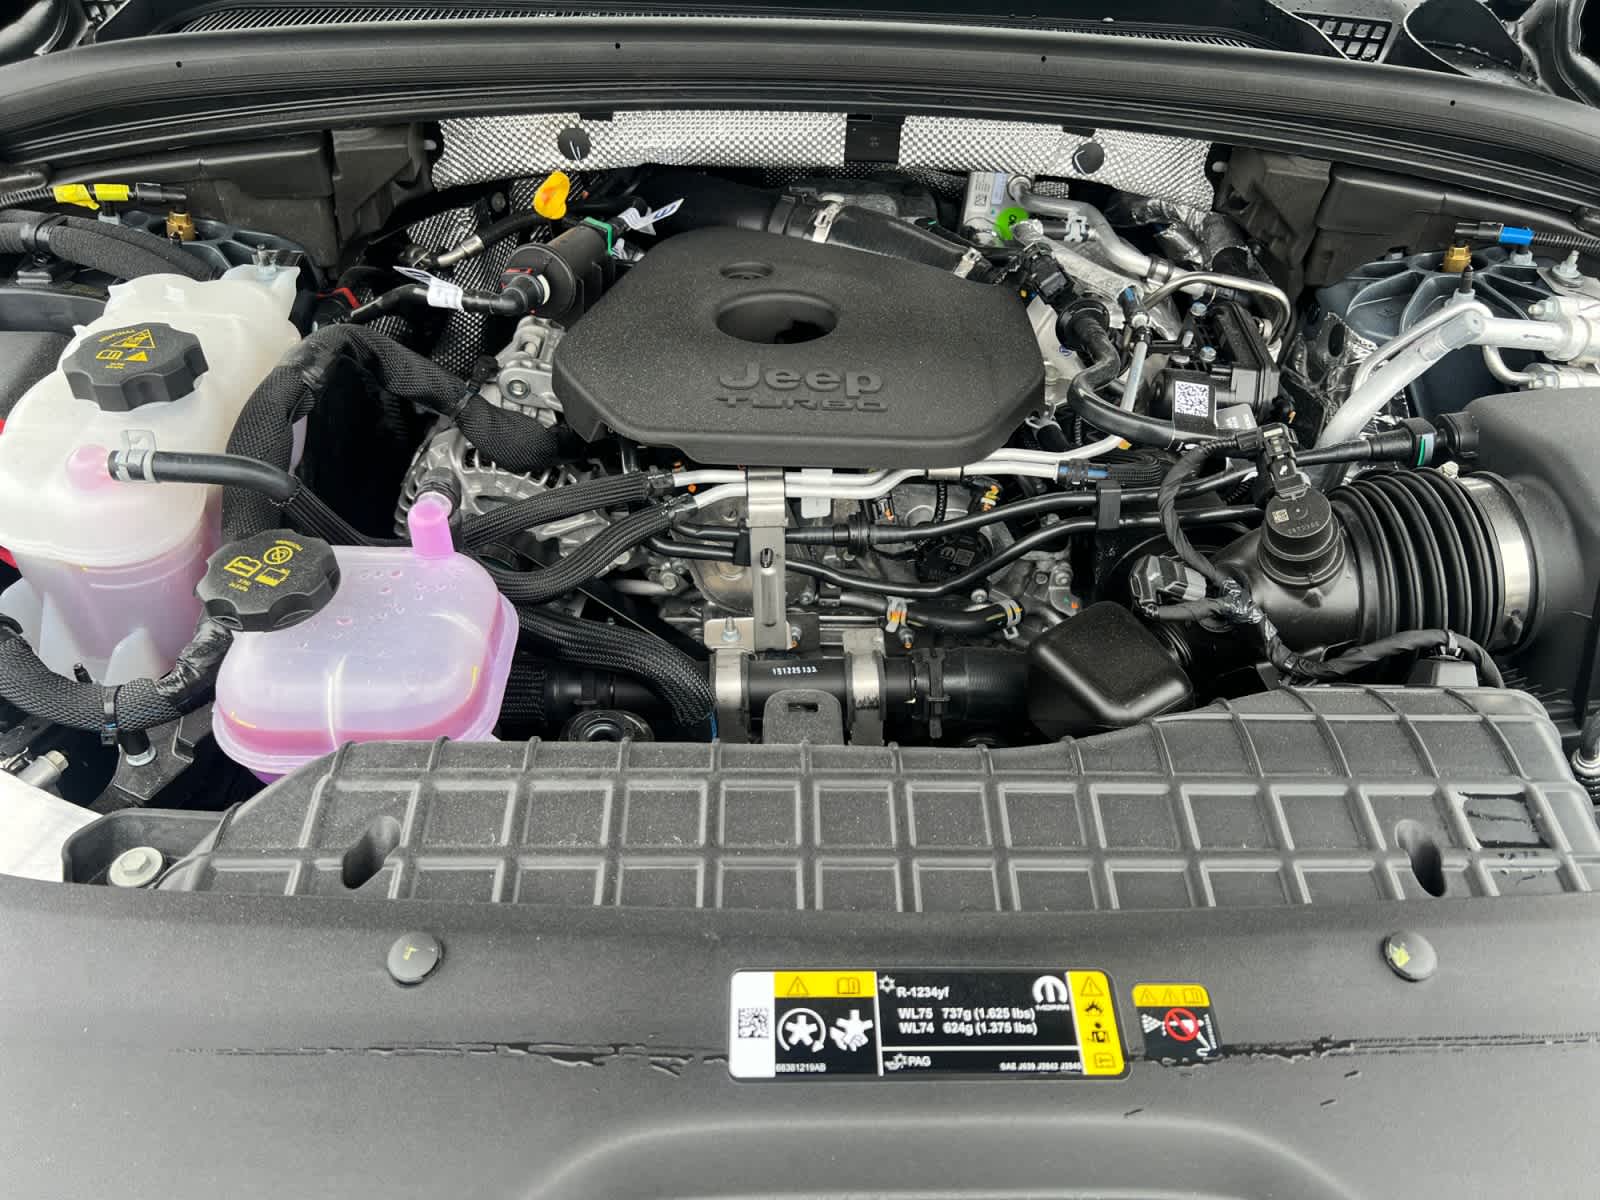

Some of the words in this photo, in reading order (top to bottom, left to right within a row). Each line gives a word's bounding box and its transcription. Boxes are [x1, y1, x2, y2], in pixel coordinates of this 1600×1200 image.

[718, 361, 884, 399] Jeep
[715, 394, 889, 412] TURBO
[896, 985, 950, 1000] R-1234yf
[897, 1007, 934, 1019] WL75
[941, 1007, 972, 1021] 737g
[973, 1007, 1010, 1021] (1.625
[1011, 1007, 1036, 1021] lbs)
[898, 1021, 935, 1034] WL74
[942, 1021, 974, 1037] 624g
[975, 1021, 1013, 1036] (1.375
[1013, 1021, 1038, 1036] lbs)
[907, 1056, 932, 1067] PAG
